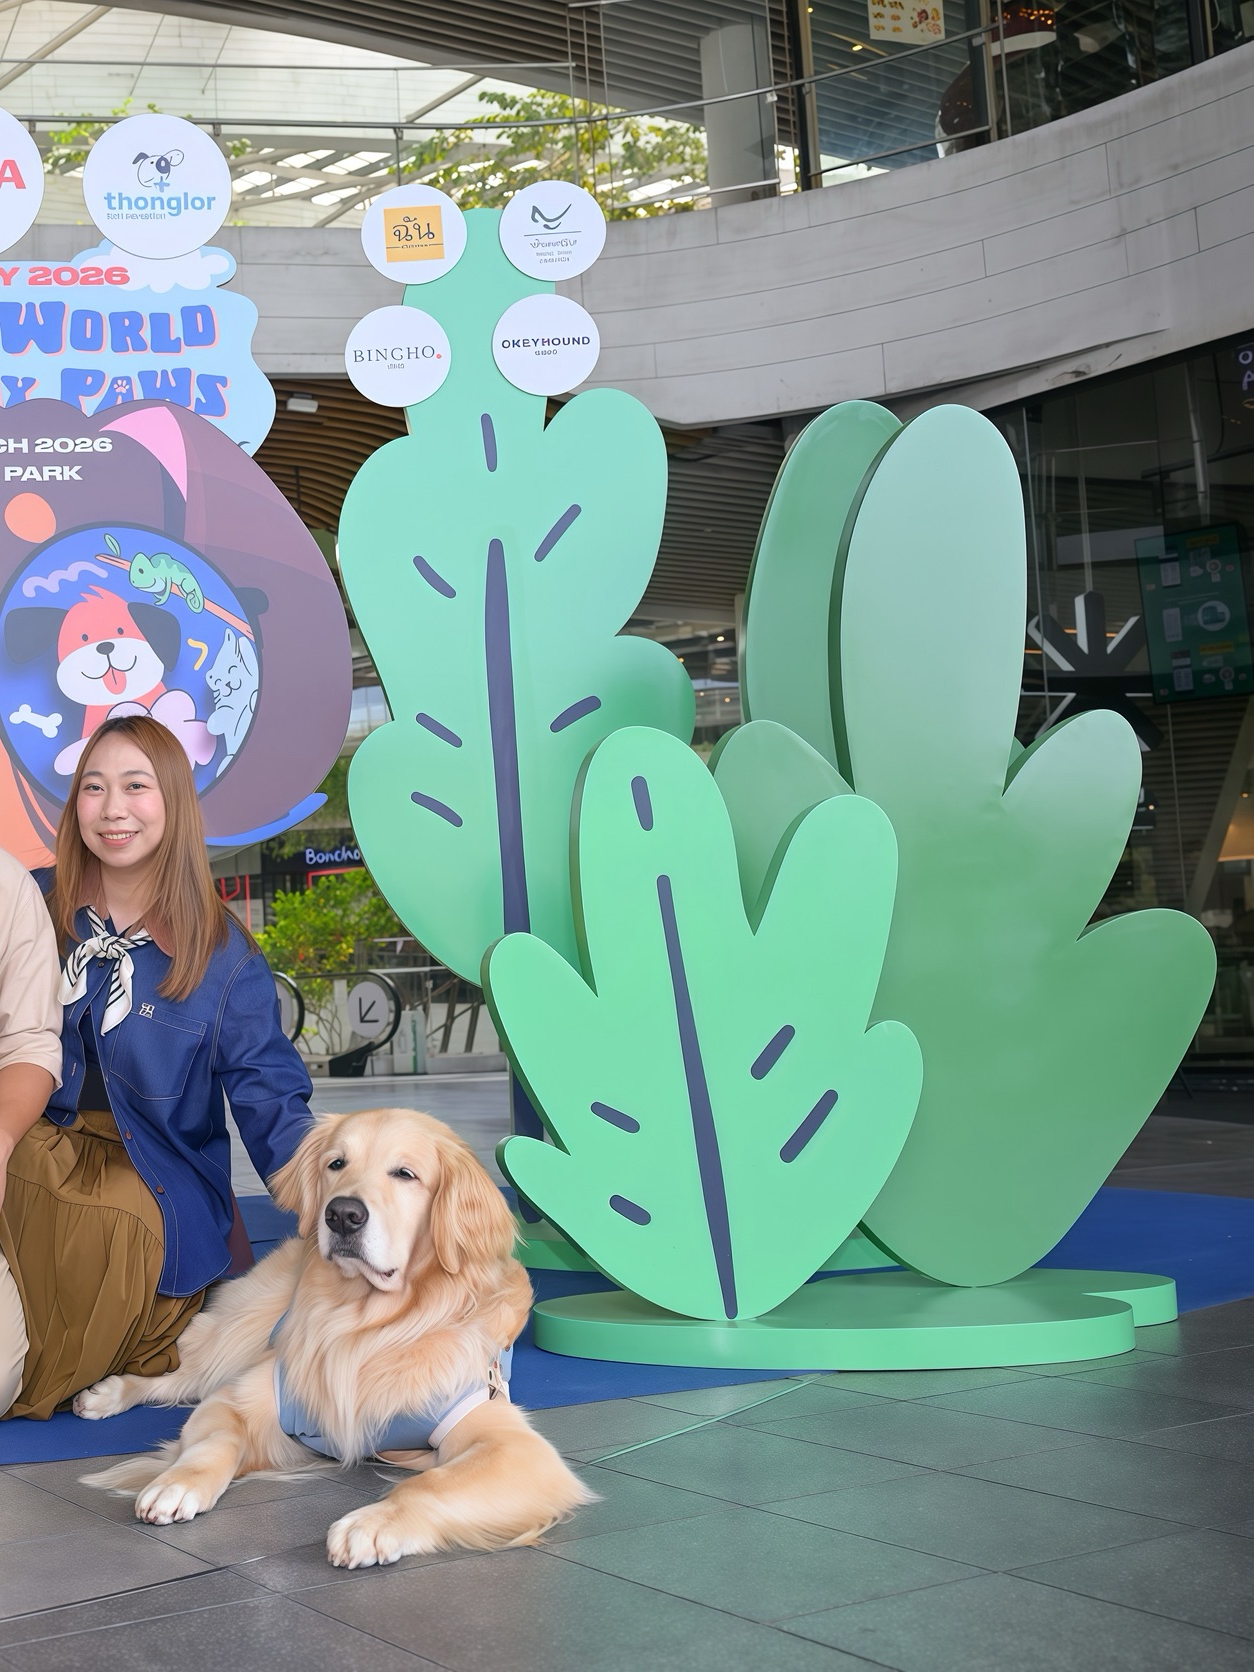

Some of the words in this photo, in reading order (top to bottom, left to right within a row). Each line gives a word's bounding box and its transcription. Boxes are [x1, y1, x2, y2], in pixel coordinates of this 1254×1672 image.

[104, 192, 216, 217] thonglor
[28, 266, 130, 286] 2026
[61, 367, 230, 419] PAWS
[34, 437, 113, 453] 2026
[4, 465, 83, 481] PARK
[305, 845, 362, 865] Boncho
